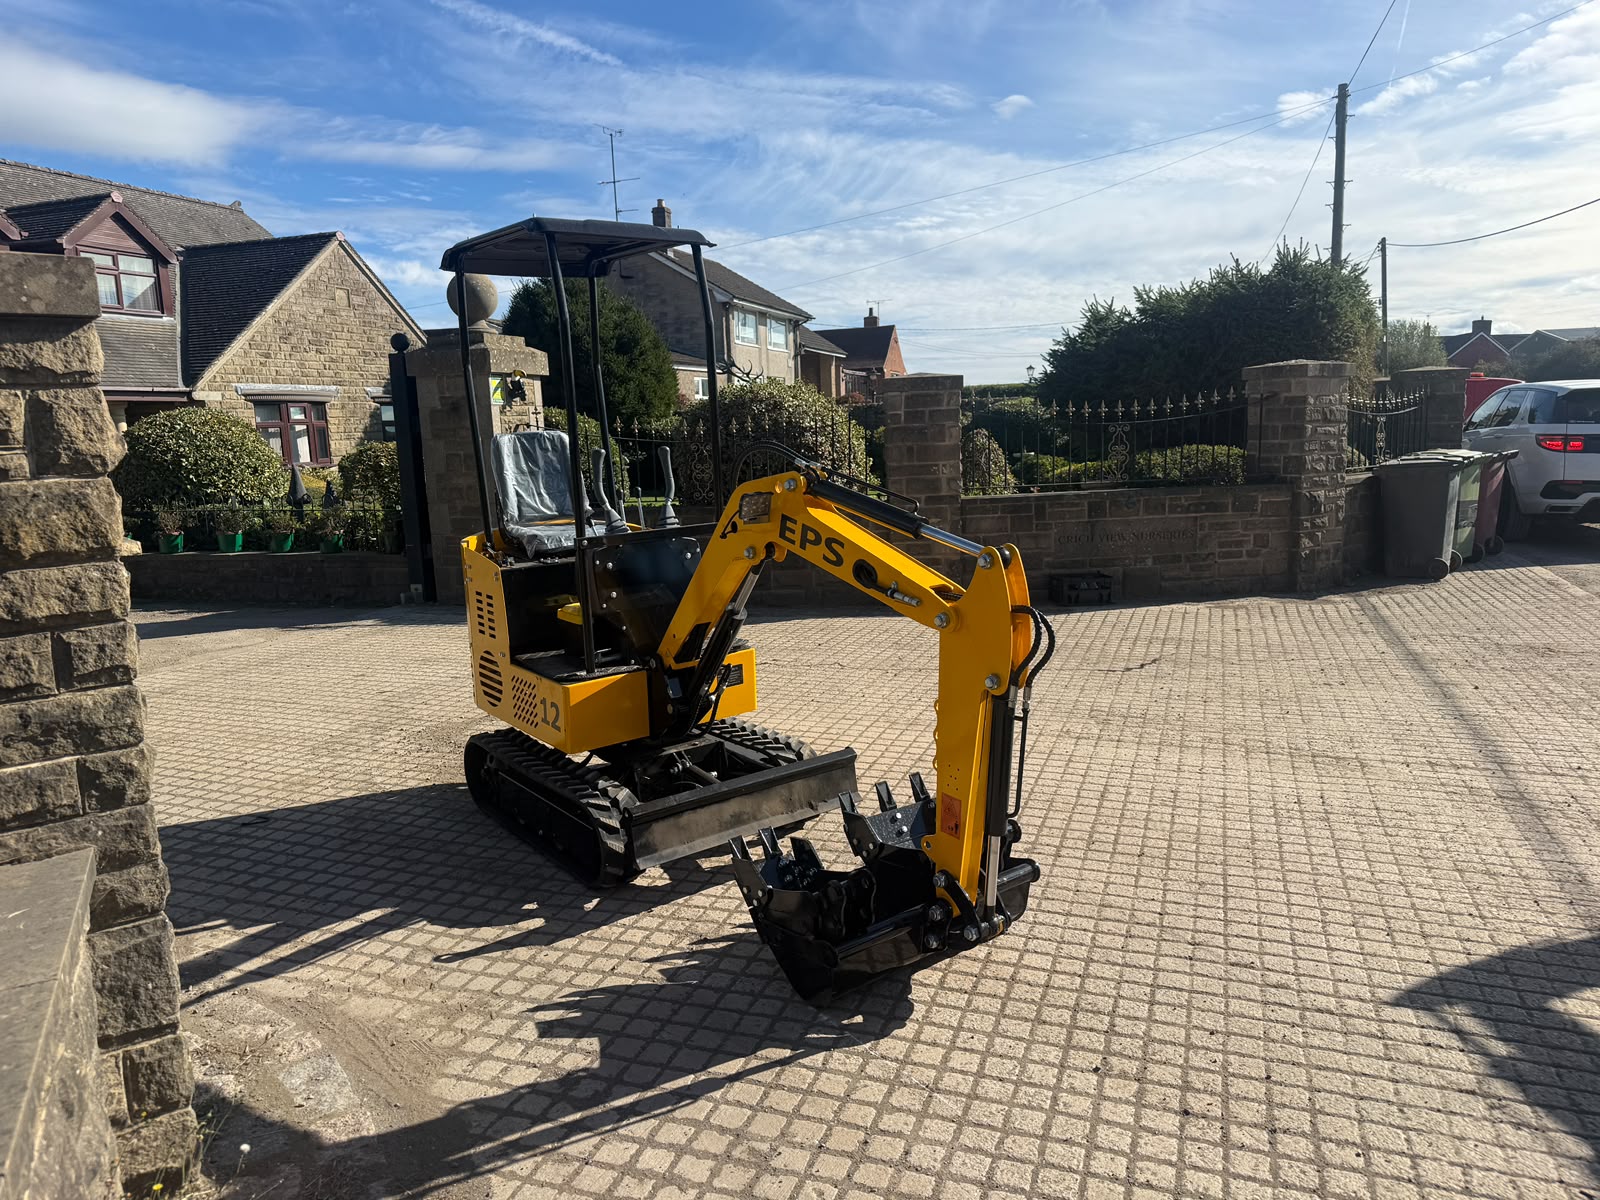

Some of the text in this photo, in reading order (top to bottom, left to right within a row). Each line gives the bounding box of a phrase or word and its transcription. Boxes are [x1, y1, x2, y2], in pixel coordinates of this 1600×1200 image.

[778, 513, 845, 568] EPS
[1098, 532, 1126, 543] VIEW
[1131, 528, 1195, 541] NURSERIES
[540, 696, 562, 733] 12
